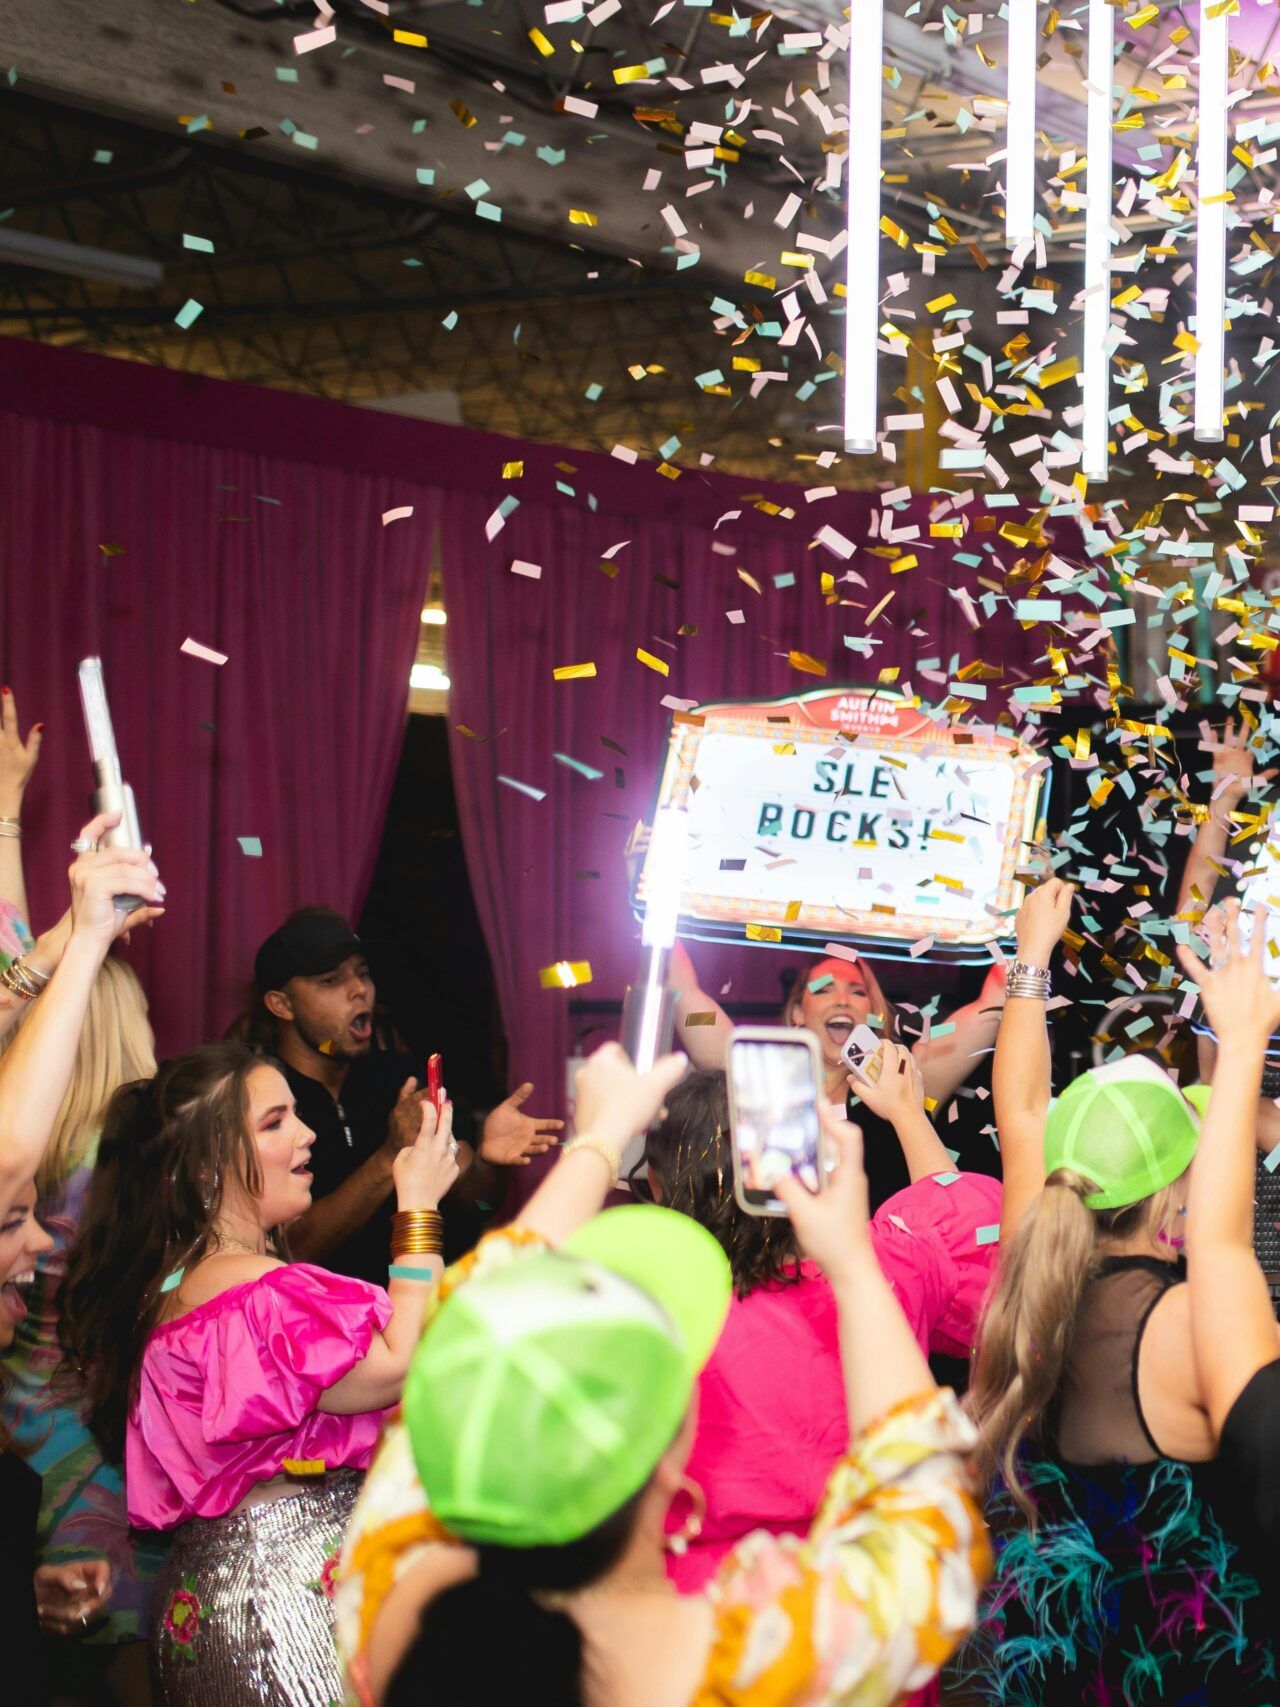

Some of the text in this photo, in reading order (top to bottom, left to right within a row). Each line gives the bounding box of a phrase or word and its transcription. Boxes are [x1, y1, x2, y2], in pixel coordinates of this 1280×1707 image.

[830, 708, 881, 726] SMITH
[838, 696, 896, 714] AUSTIN
[813, 760, 890, 799] SLE
[757, 802, 931, 850] ROCKS!
